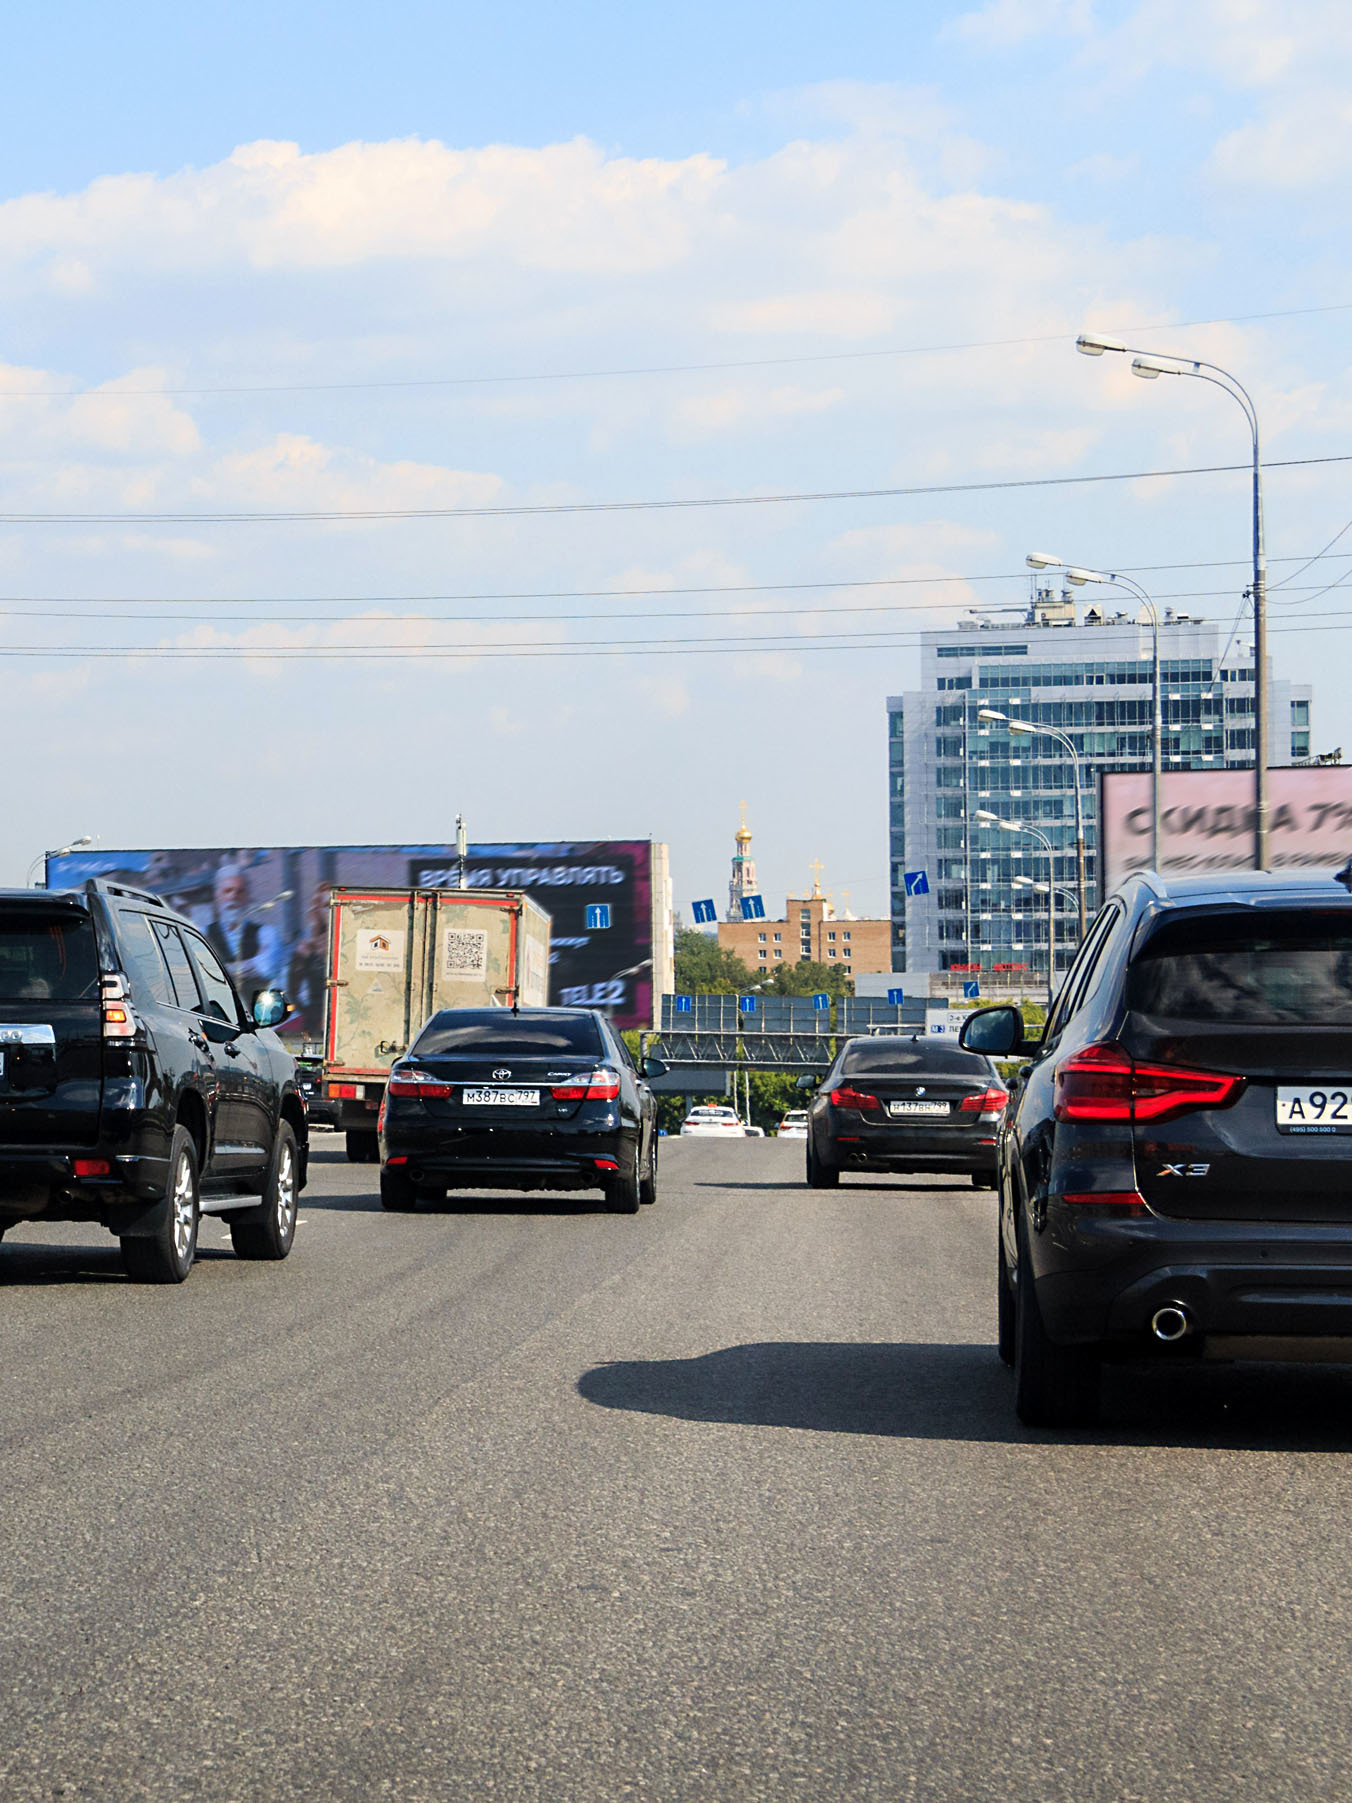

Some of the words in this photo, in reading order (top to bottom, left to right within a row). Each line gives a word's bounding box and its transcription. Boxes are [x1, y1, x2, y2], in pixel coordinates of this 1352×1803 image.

[418, 868, 493, 888] ВРЕМЯ
[496, 865, 625, 887] УПРАВЛЯТЬ
[559, 980, 626, 1006] TELE2
[467, 1090, 515, 1103] М387ВС
[517, 1090, 535, 1100] 797
[1288, 1091, 1352, 1119] А92
[1156, 1163, 1210, 1176] X3
